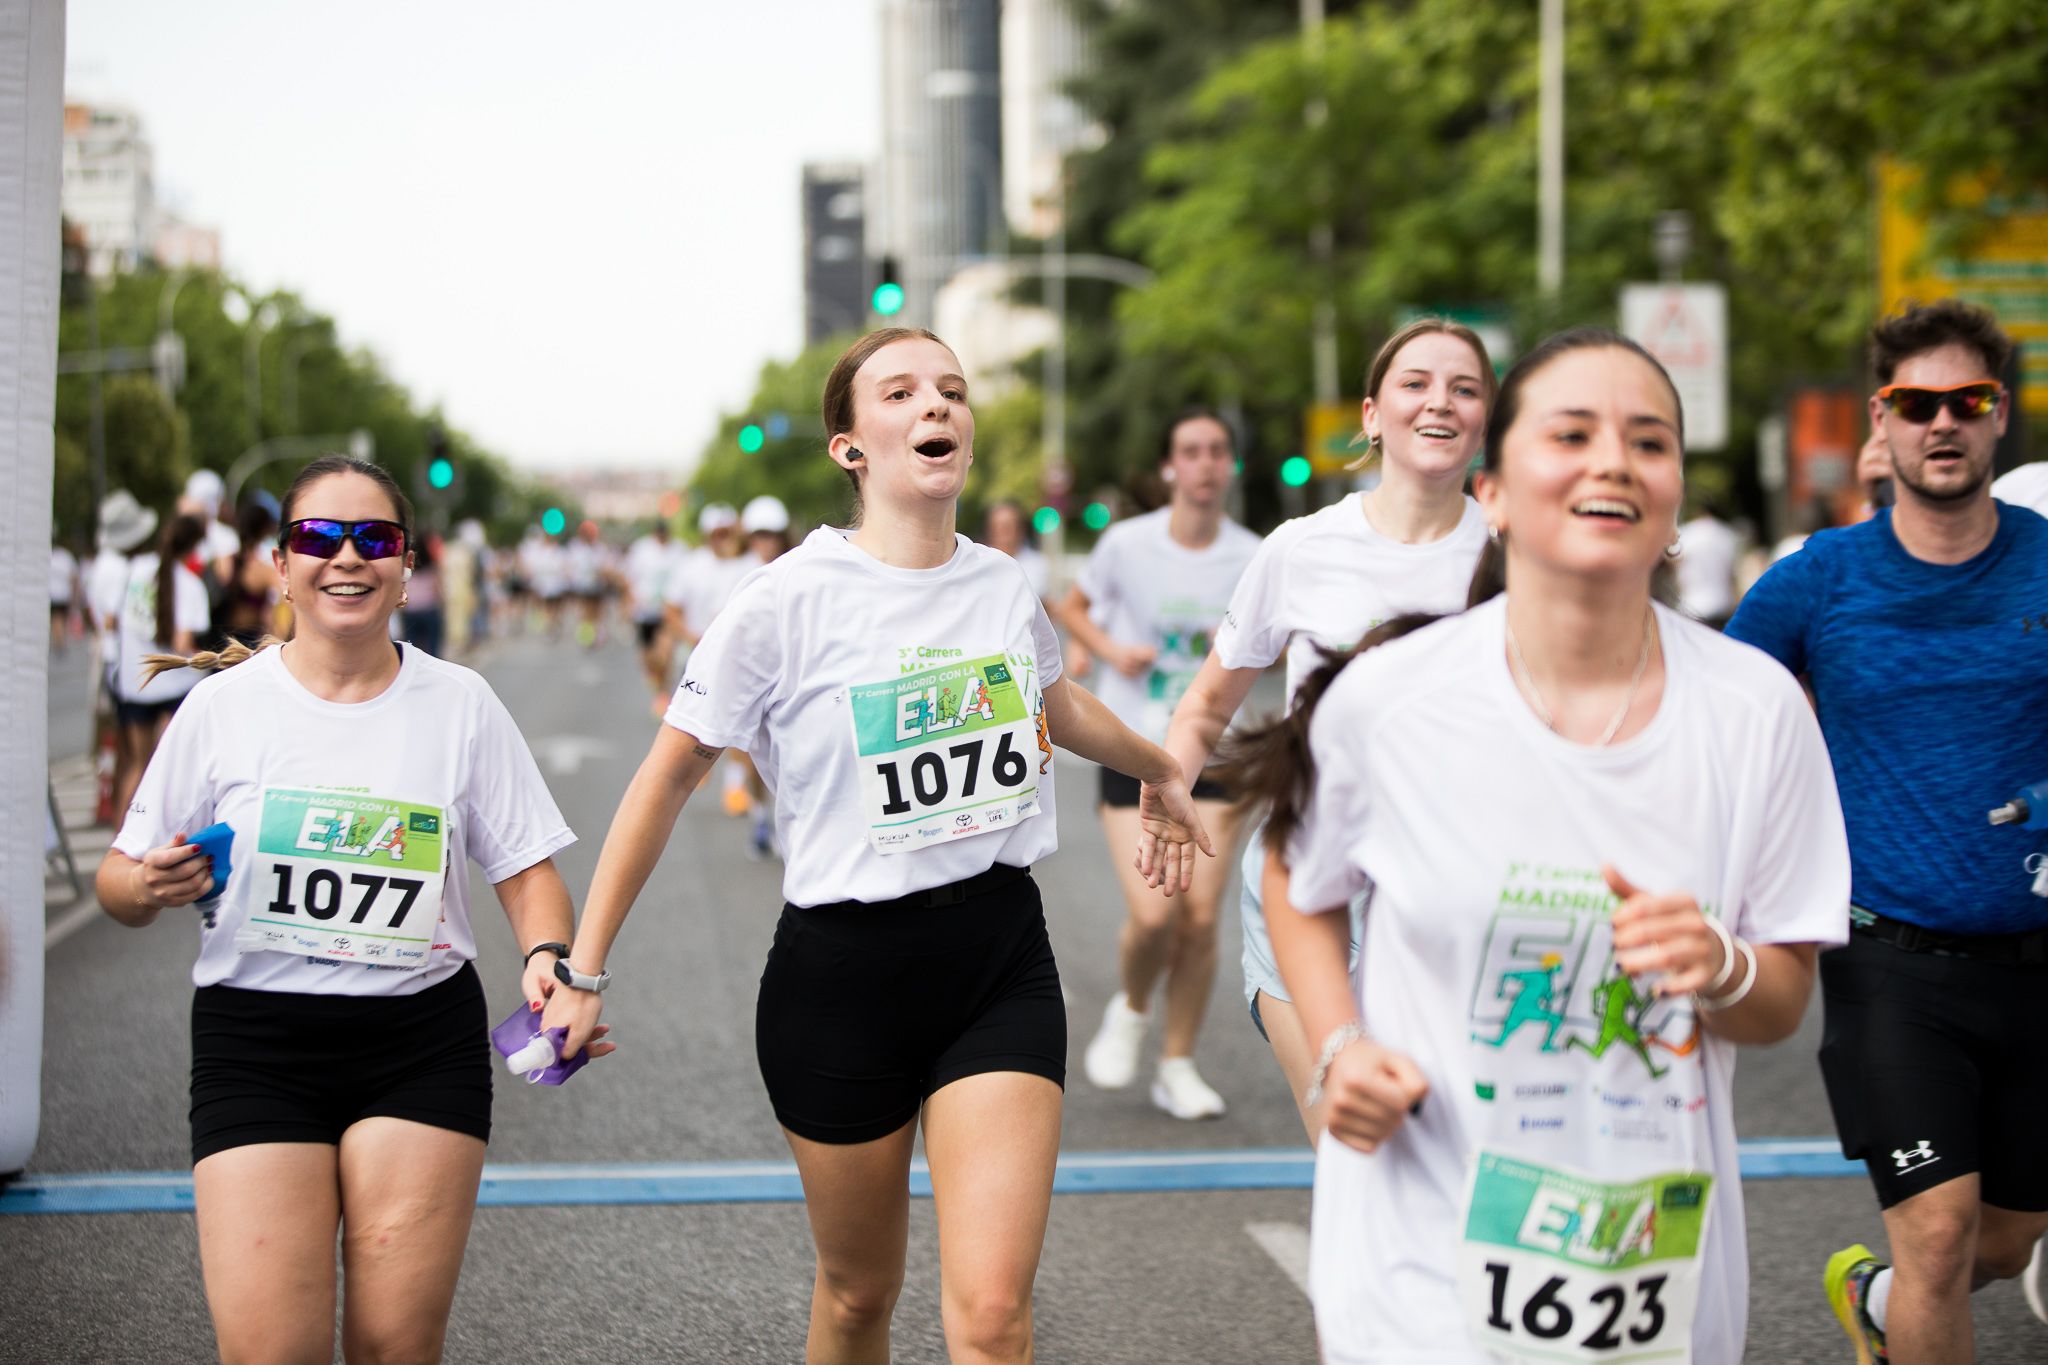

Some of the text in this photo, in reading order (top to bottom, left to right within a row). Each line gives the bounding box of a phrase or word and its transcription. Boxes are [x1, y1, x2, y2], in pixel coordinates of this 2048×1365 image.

[866, 688, 895, 698] Carrera
[896, 675, 937, 694] MADRID
[939, 668, 961, 682] CON
[964, 665, 977, 677] LA
[917, 646, 963, 658] Carrera
[895, 676, 995, 743] ELA
[876, 731, 1028, 816] 1076
[295, 806, 404, 861] ELA
[308, 796, 356, 811] MADRID
[358, 801, 384, 812] CON
[385, 804, 400, 815] LA
[988, 814, 1002, 823] LIFE
[268, 863, 425, 928] 1077
[1515, 1186, 1659, 1265] ELA
[1484, 1261, 1669, 1350] 1623
